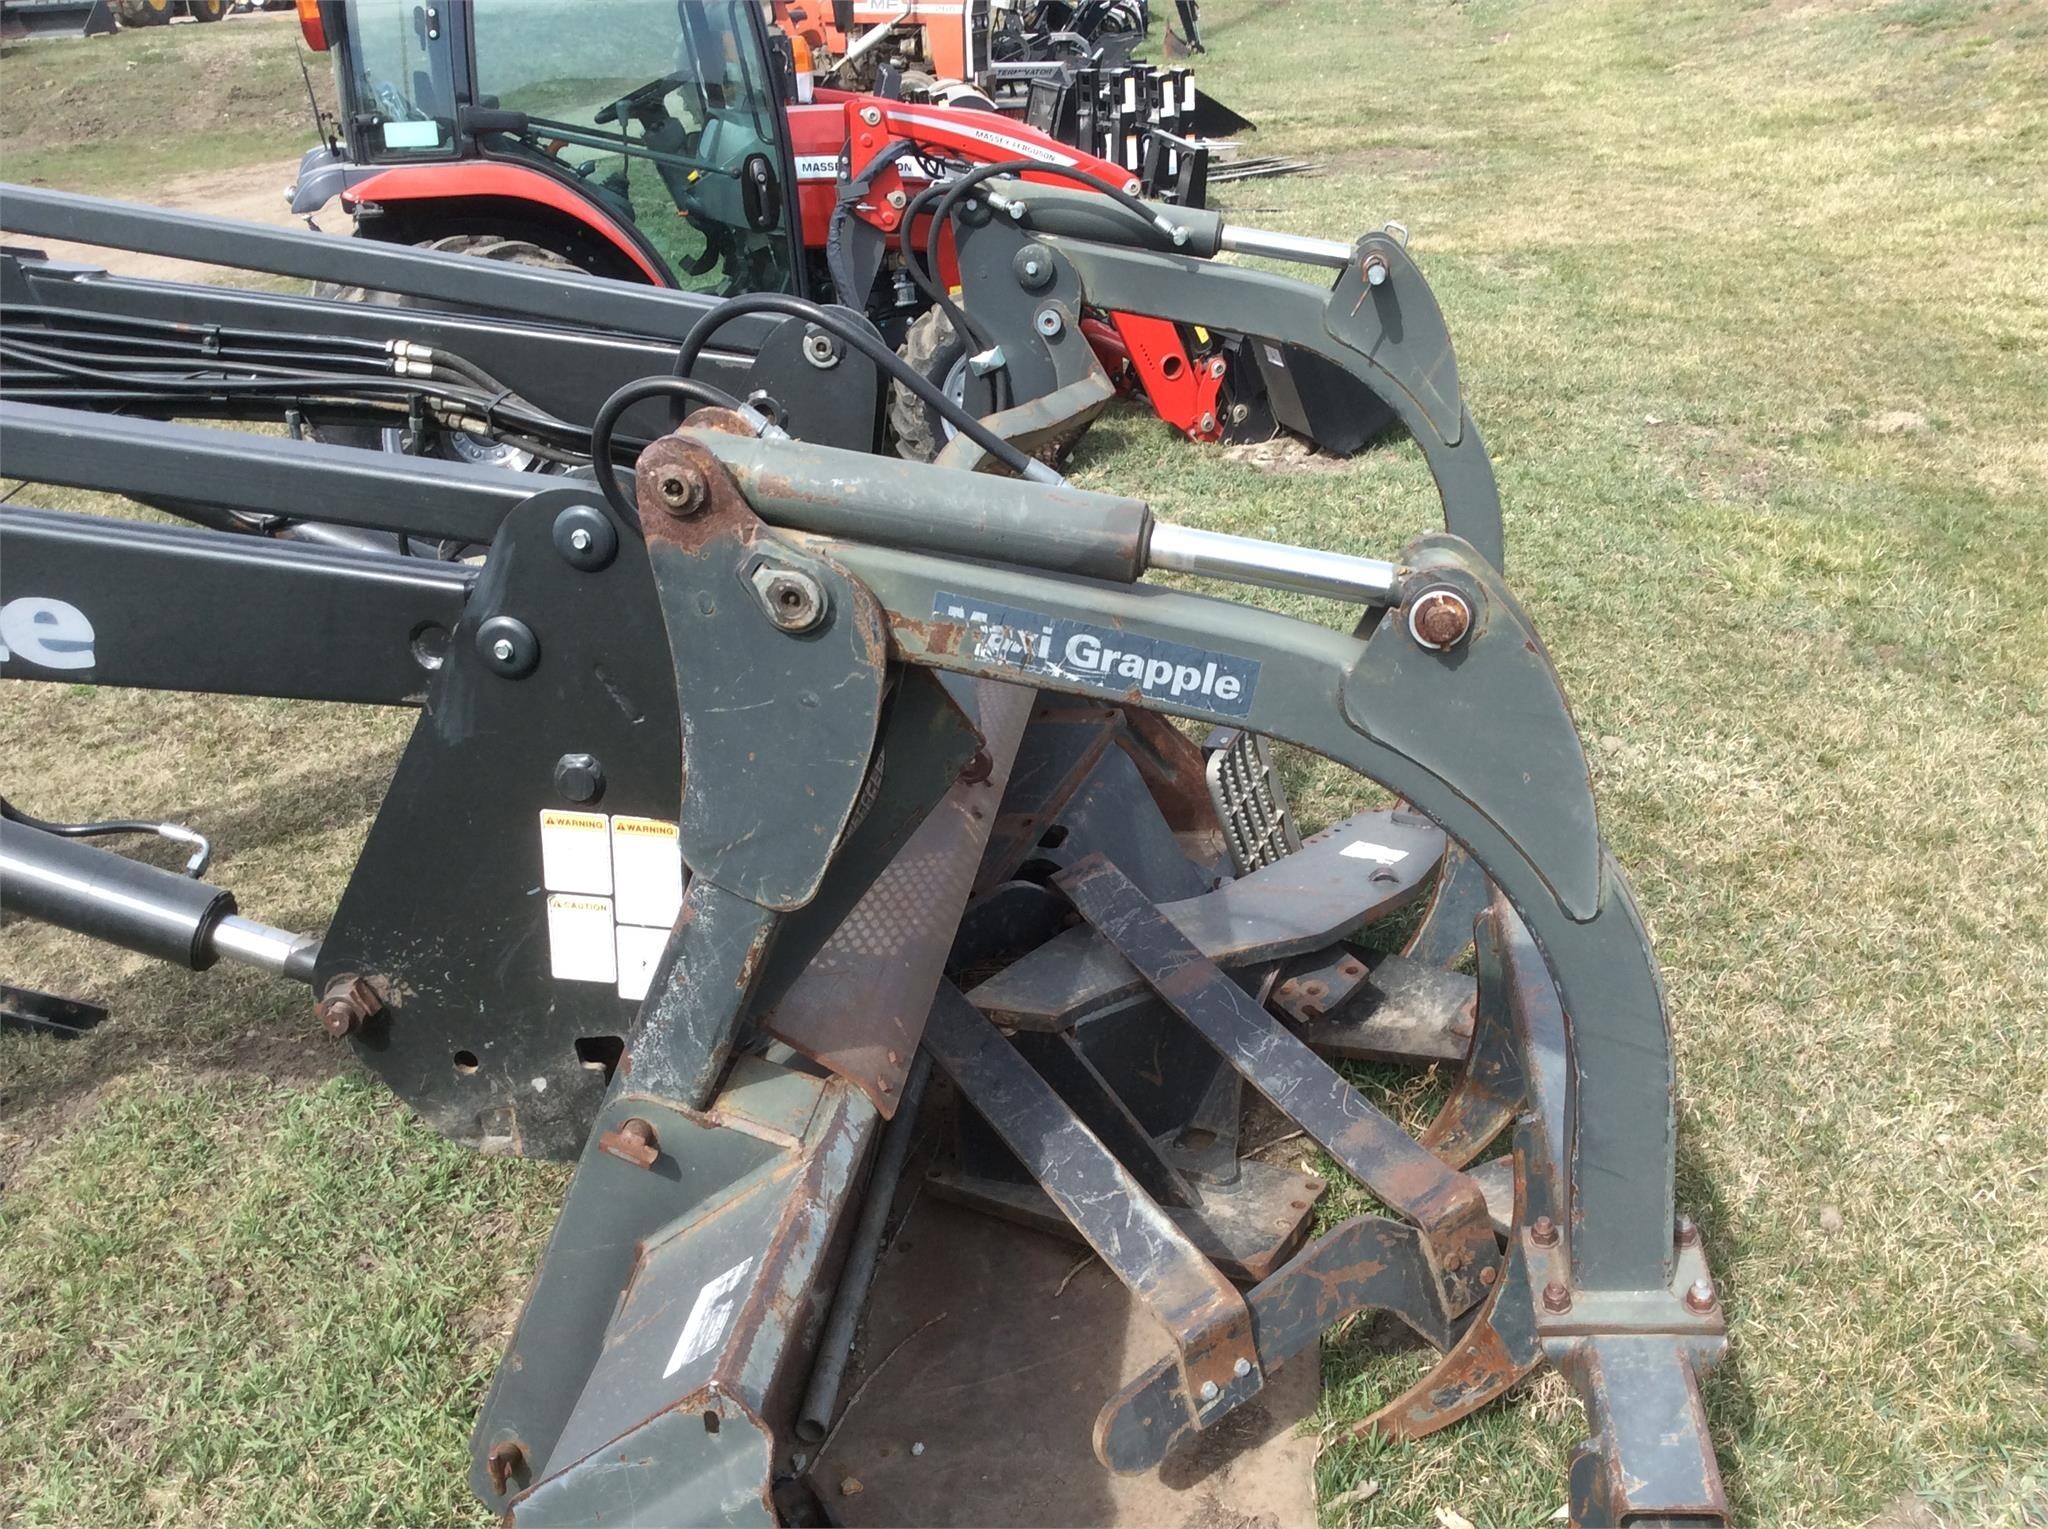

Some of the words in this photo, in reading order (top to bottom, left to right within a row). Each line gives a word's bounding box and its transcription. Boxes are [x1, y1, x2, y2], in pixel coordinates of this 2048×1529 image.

[802, 162, 840, 172] MASSE
[1064, 633, 1241, 700] Grapple
[557, 818, 603, 829] WARNING
[626, 824, 674, 835] WARNING
[564, 901, 607, 912] CAUTION
